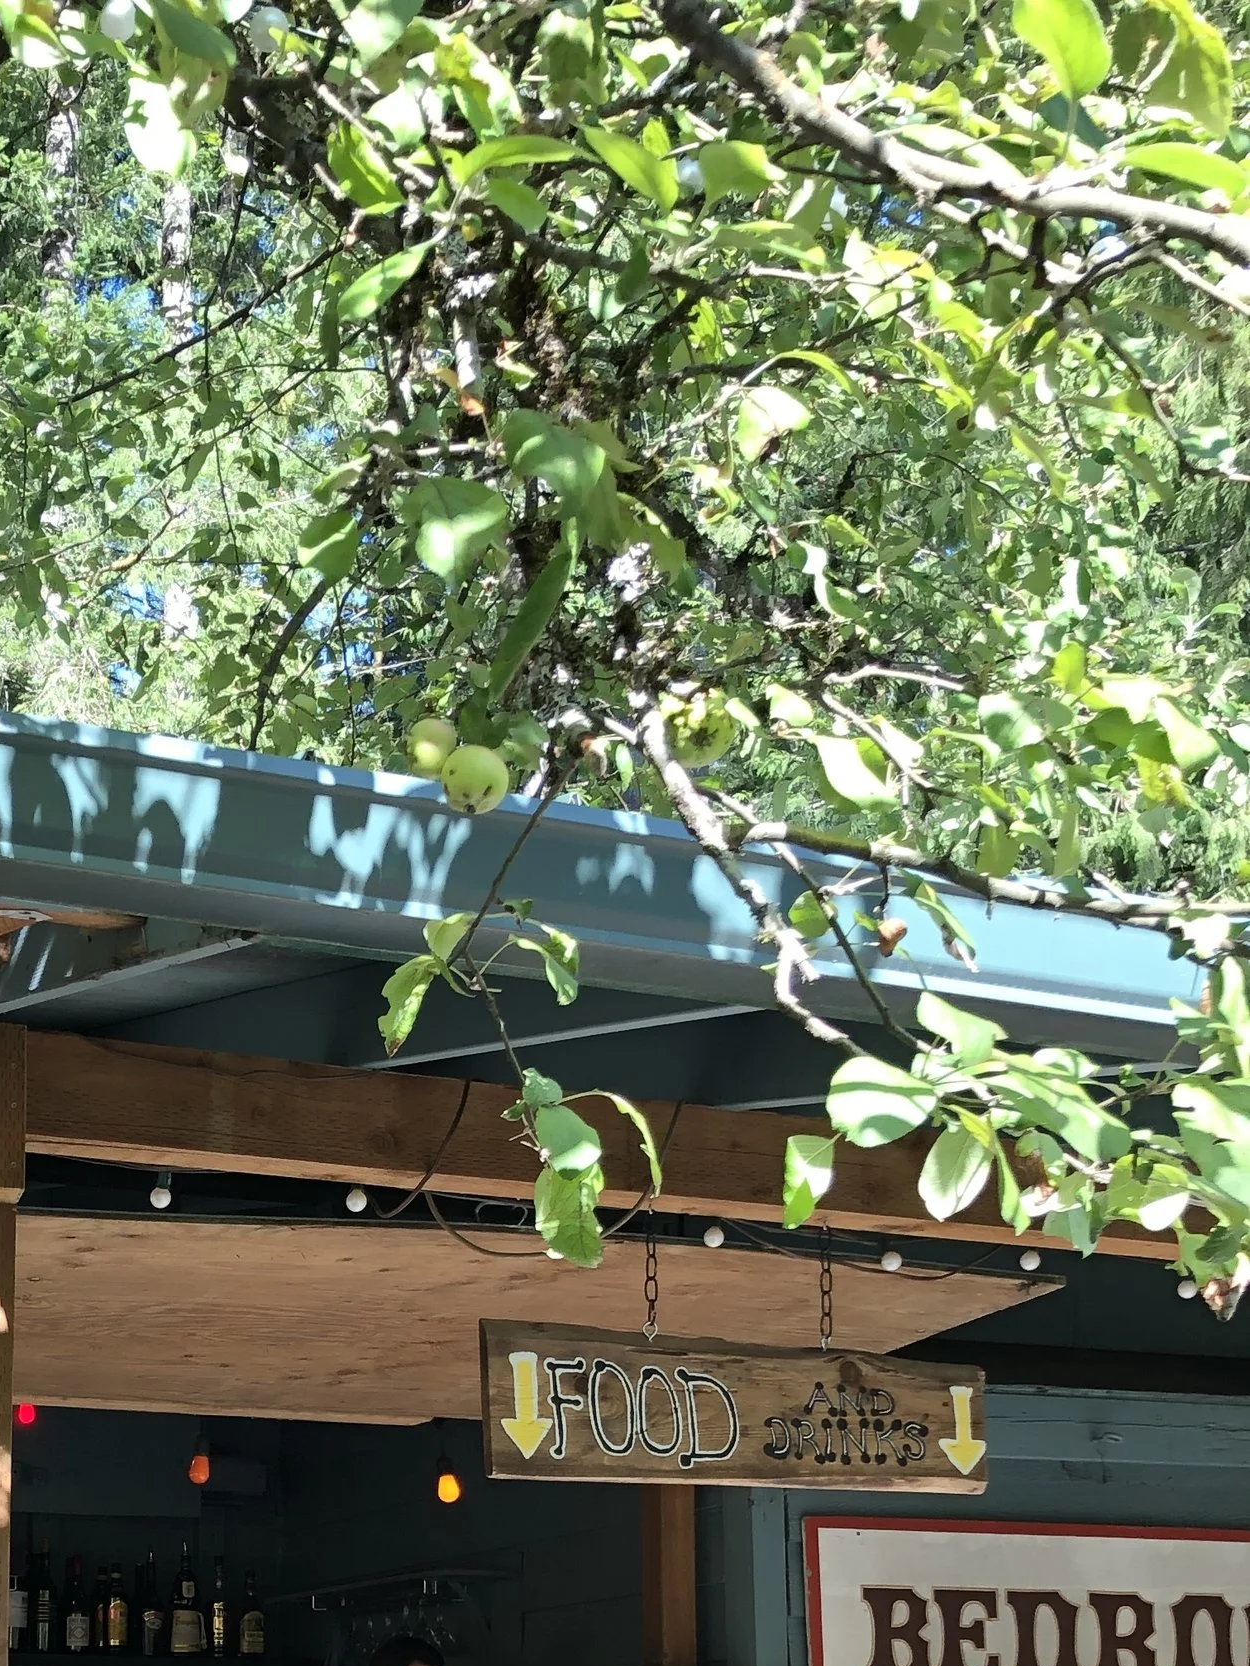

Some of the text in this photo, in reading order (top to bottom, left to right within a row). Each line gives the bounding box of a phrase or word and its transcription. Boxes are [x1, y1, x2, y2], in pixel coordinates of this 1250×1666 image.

[545, 1356, 738, 1469] FOOD
[804, 1382, 895, 1416] AND
[763, 1417, 928, 1467] DRINKS
